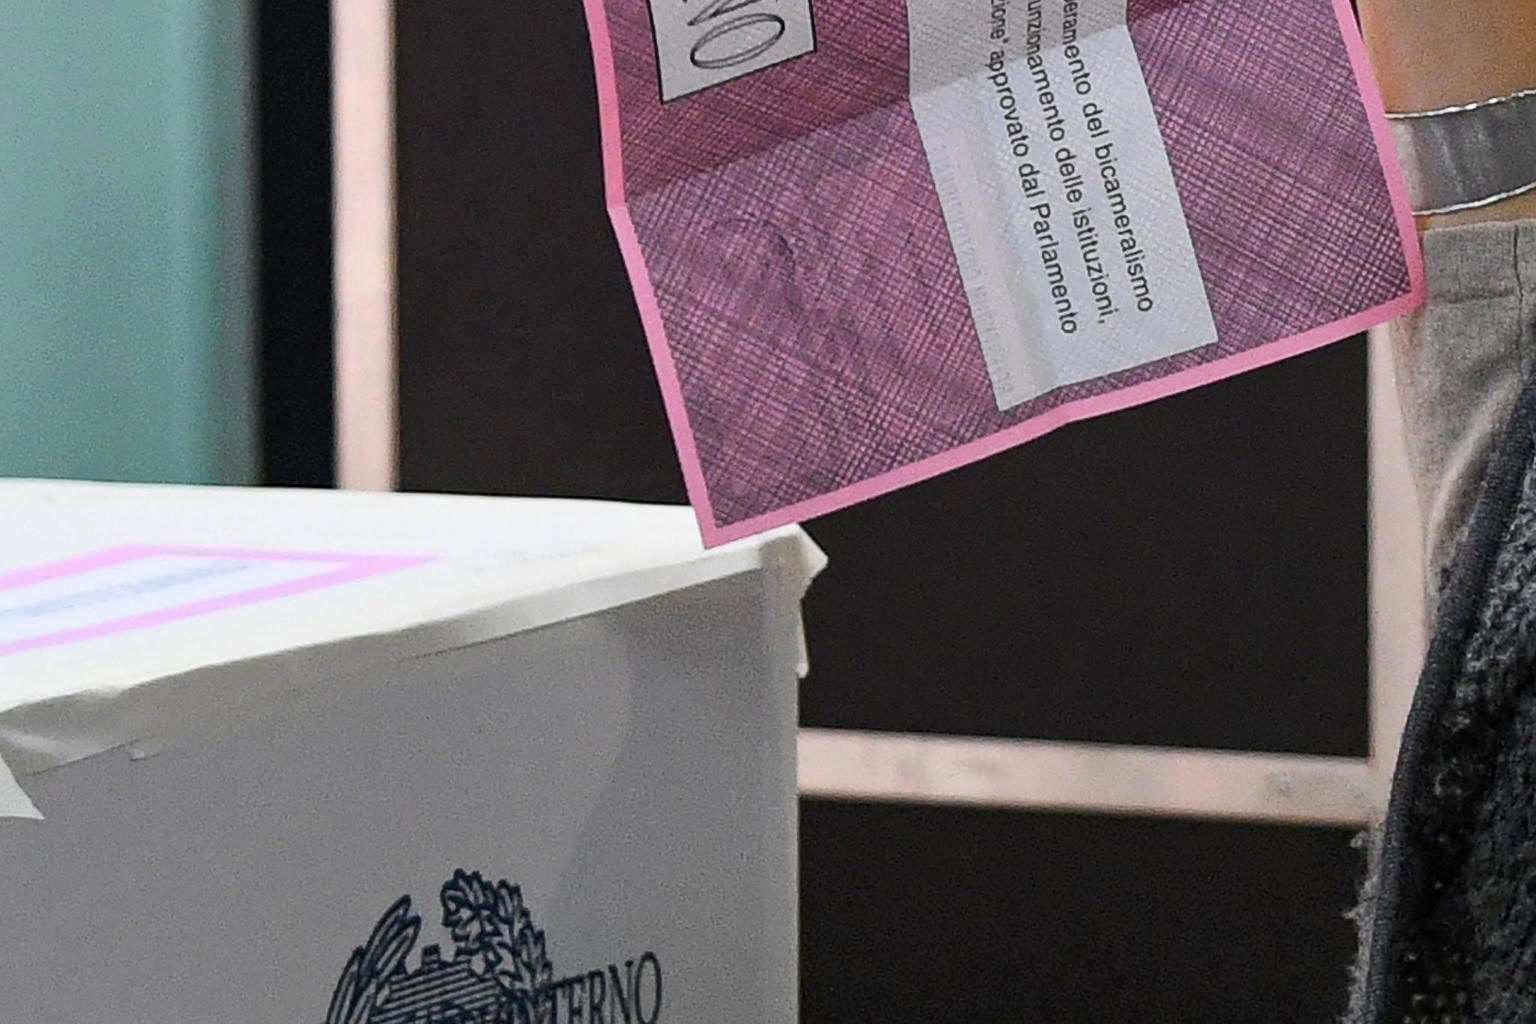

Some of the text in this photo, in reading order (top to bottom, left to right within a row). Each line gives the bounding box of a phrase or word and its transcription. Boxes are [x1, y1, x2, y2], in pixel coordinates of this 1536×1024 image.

[984, 52, 1029, 157] approvato
[1082, 102, 1110, 139] del
[1018, 163, 1045, 199] dal
[1055, 147, 1084, 204] delle
[1072, 206, 1120, 324] istituzioni,
[1094, 142, 1153, 313] bicameralismo
[1030, 203, 1078, 334] Parlamento
